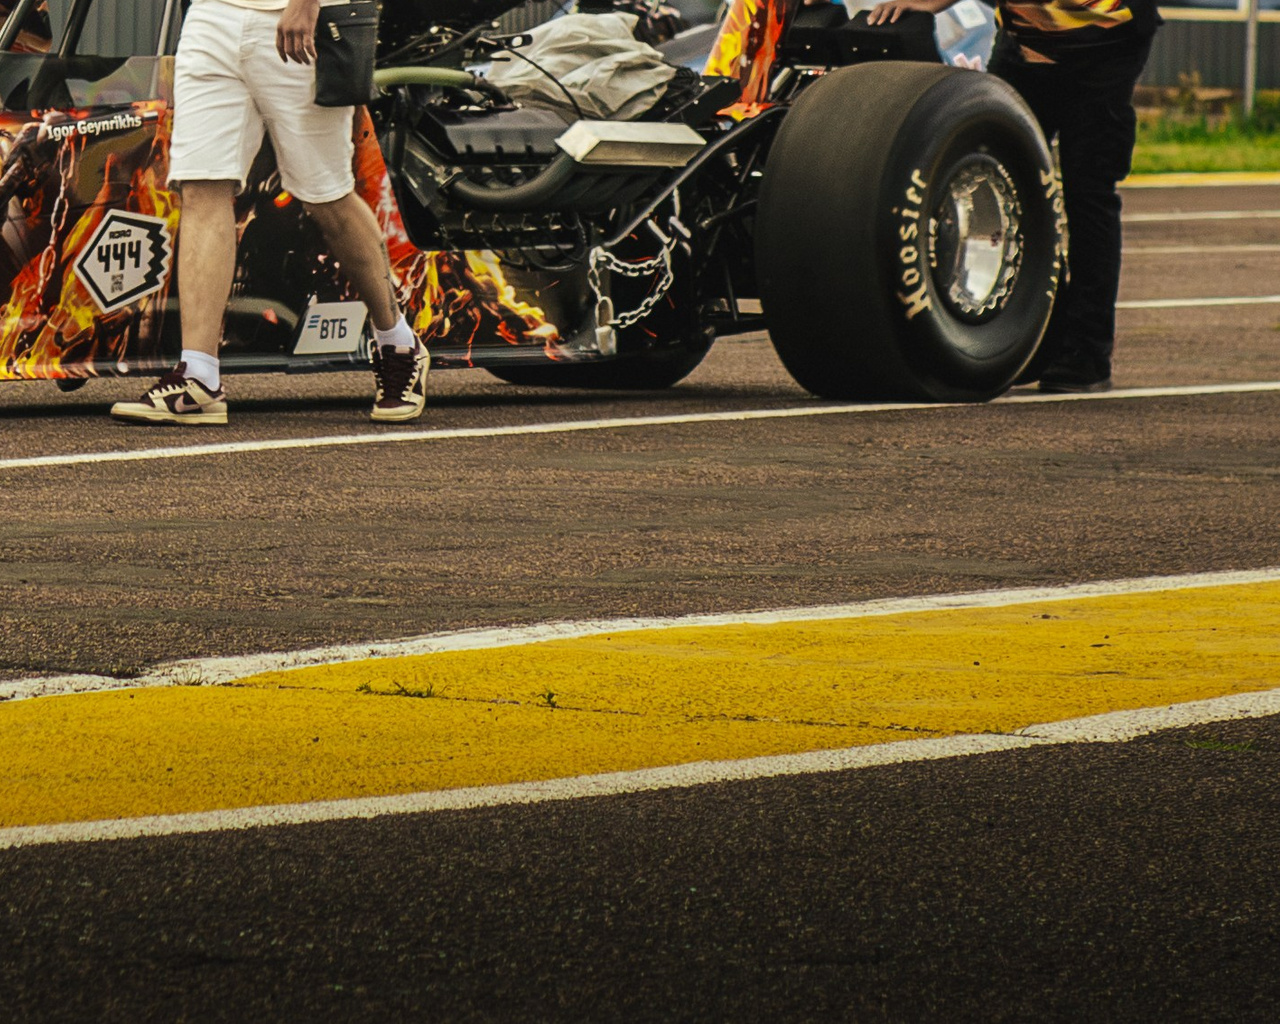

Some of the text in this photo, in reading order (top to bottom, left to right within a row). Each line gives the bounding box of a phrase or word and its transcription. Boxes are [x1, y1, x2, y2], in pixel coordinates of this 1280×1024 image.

[48, 114, 142, 142] Igor Geynrikhs
[97, 240, 142, 273] 444
[892, 169, 933, 319] Hoosier
[320, 318, 348, 340] ВТБ
